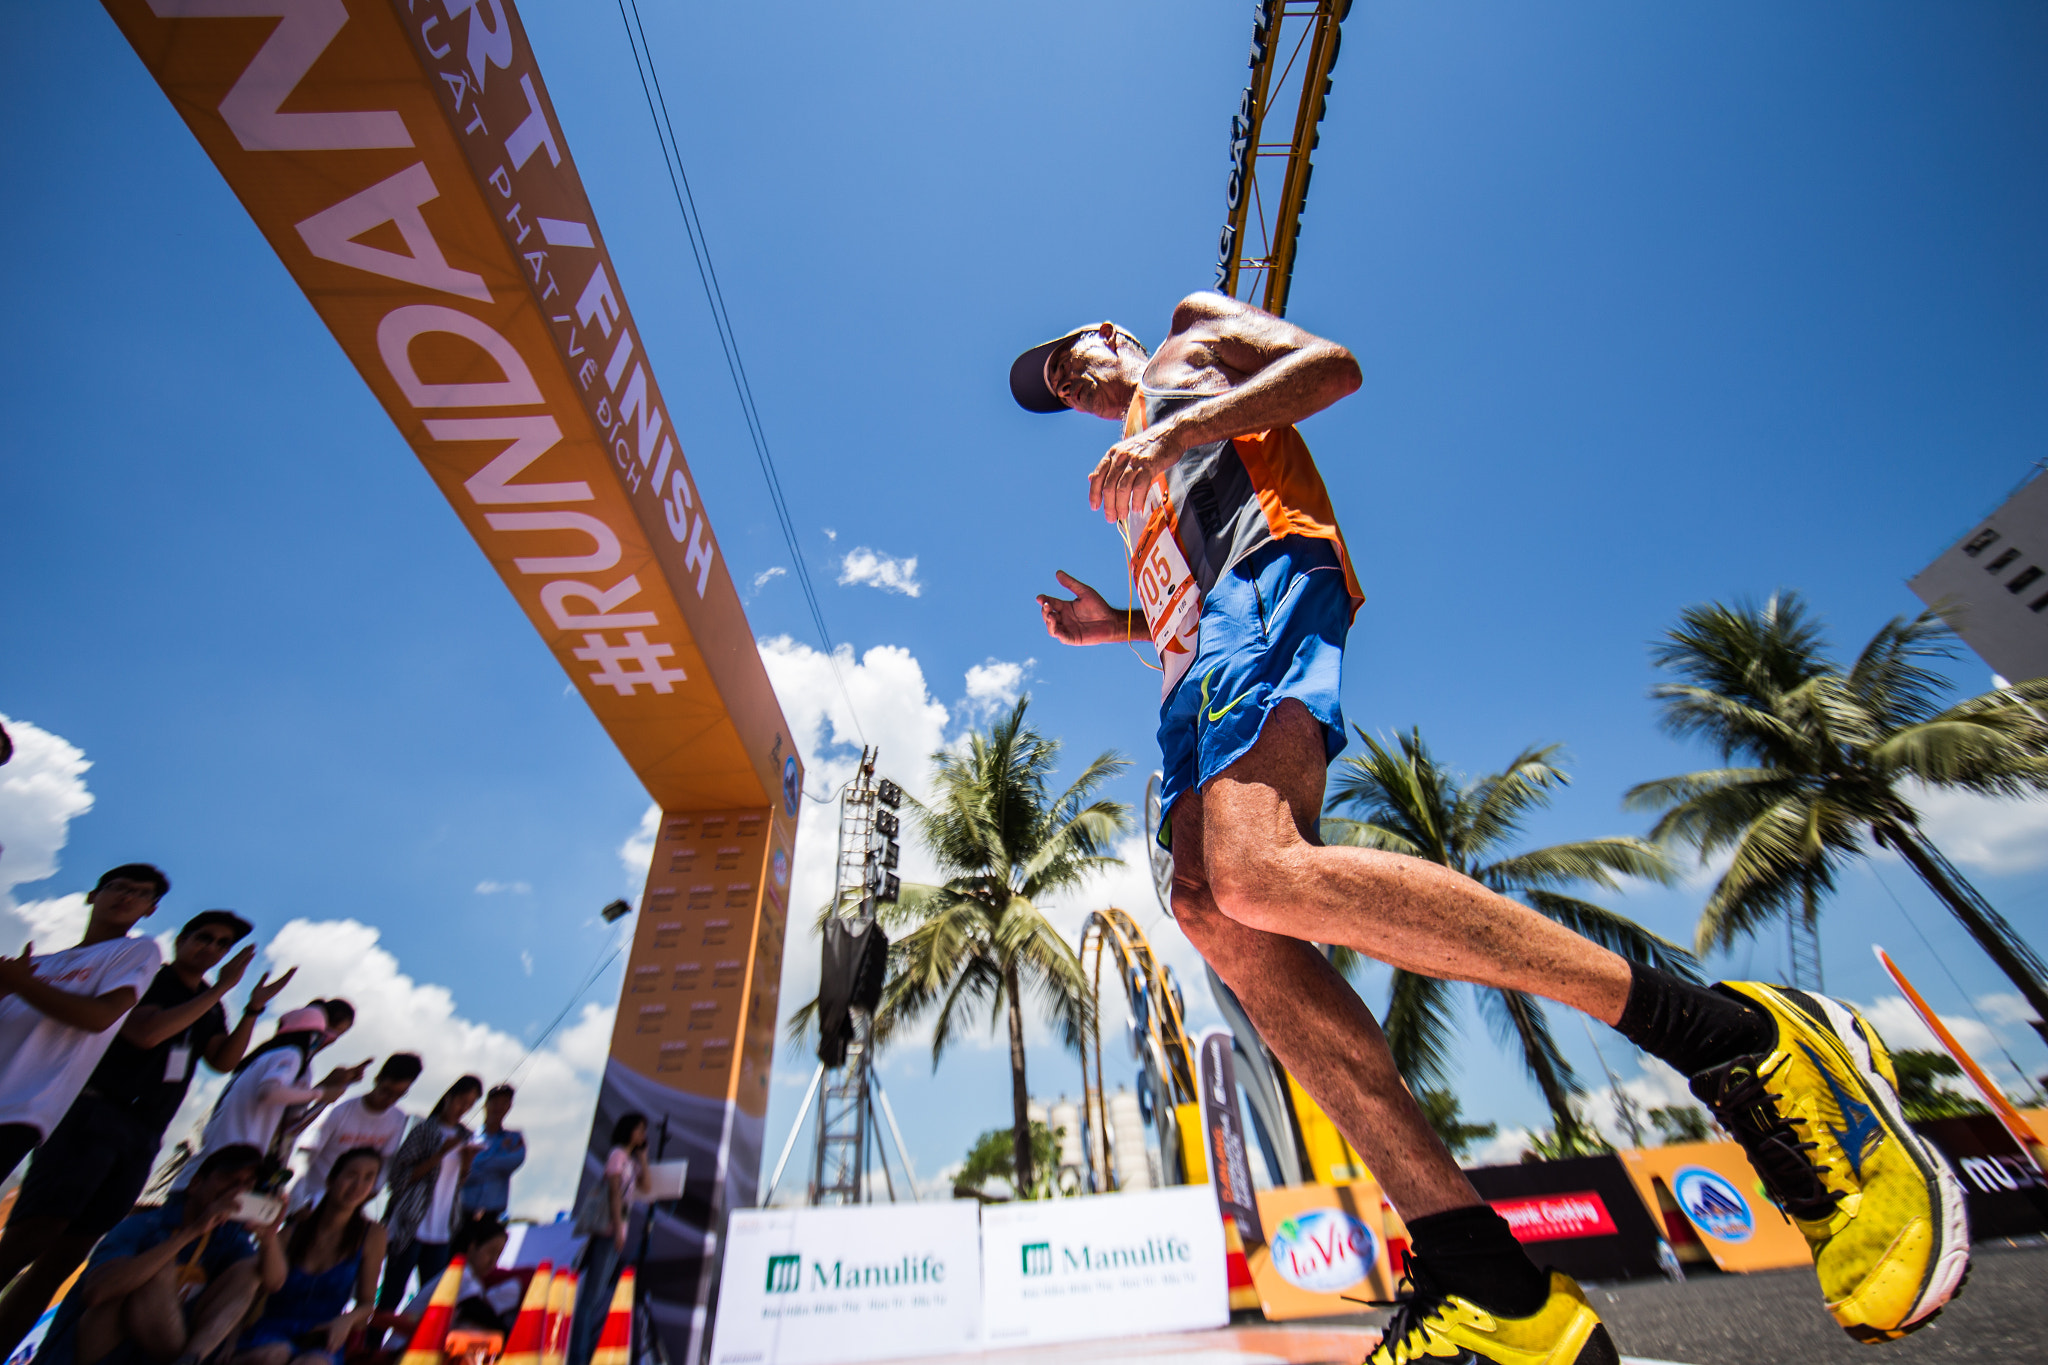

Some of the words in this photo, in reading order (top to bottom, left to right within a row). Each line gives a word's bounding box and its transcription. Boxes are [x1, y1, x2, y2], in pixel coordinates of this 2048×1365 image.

[408, 0, 489, 136] UẤT
[575, 261, 714, 600] FINISH
[811, 1255, 946, 1292] Manulife
[1063, 1236, 1192, 1274] Manulife
